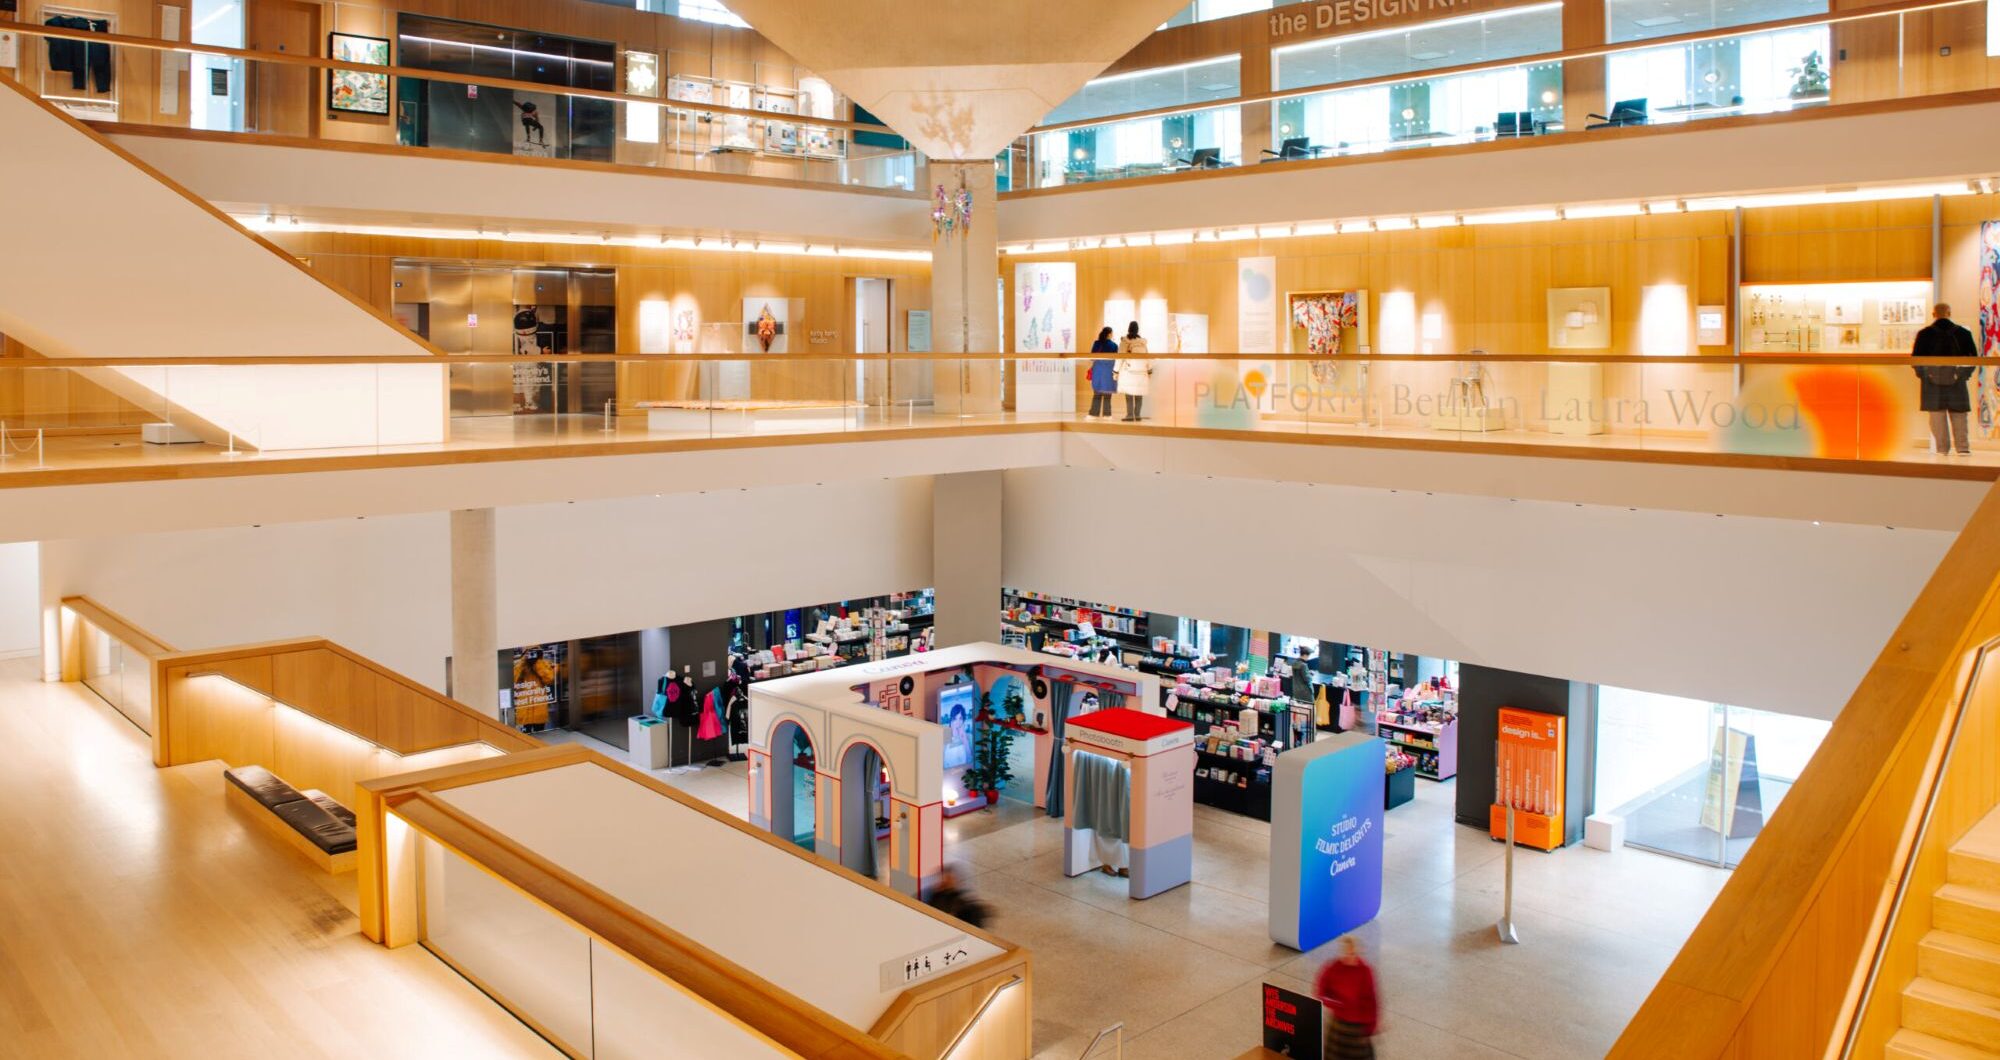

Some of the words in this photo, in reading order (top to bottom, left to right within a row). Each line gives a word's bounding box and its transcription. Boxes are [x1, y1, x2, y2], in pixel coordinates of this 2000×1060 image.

[1269, 13, 1307, 37] the
[1316, 0, 1421, 29] DESIGN
[1391, 383, 1519, 420] Bethan
[1539, 387, 1652, 425] Laura
[1663, 388, 1802, 430] Wood
[1080, 730, 1124, 747] Photobooth
[1501, 724, 1531, 739] design
[1315, 837, 1340, 855] FILMIC
[1340, 817, 1373, 854] DELIGHTS
[1331, 816, 1358, 838] STUDIO
[1330, 856, 1357, 877] Canva
